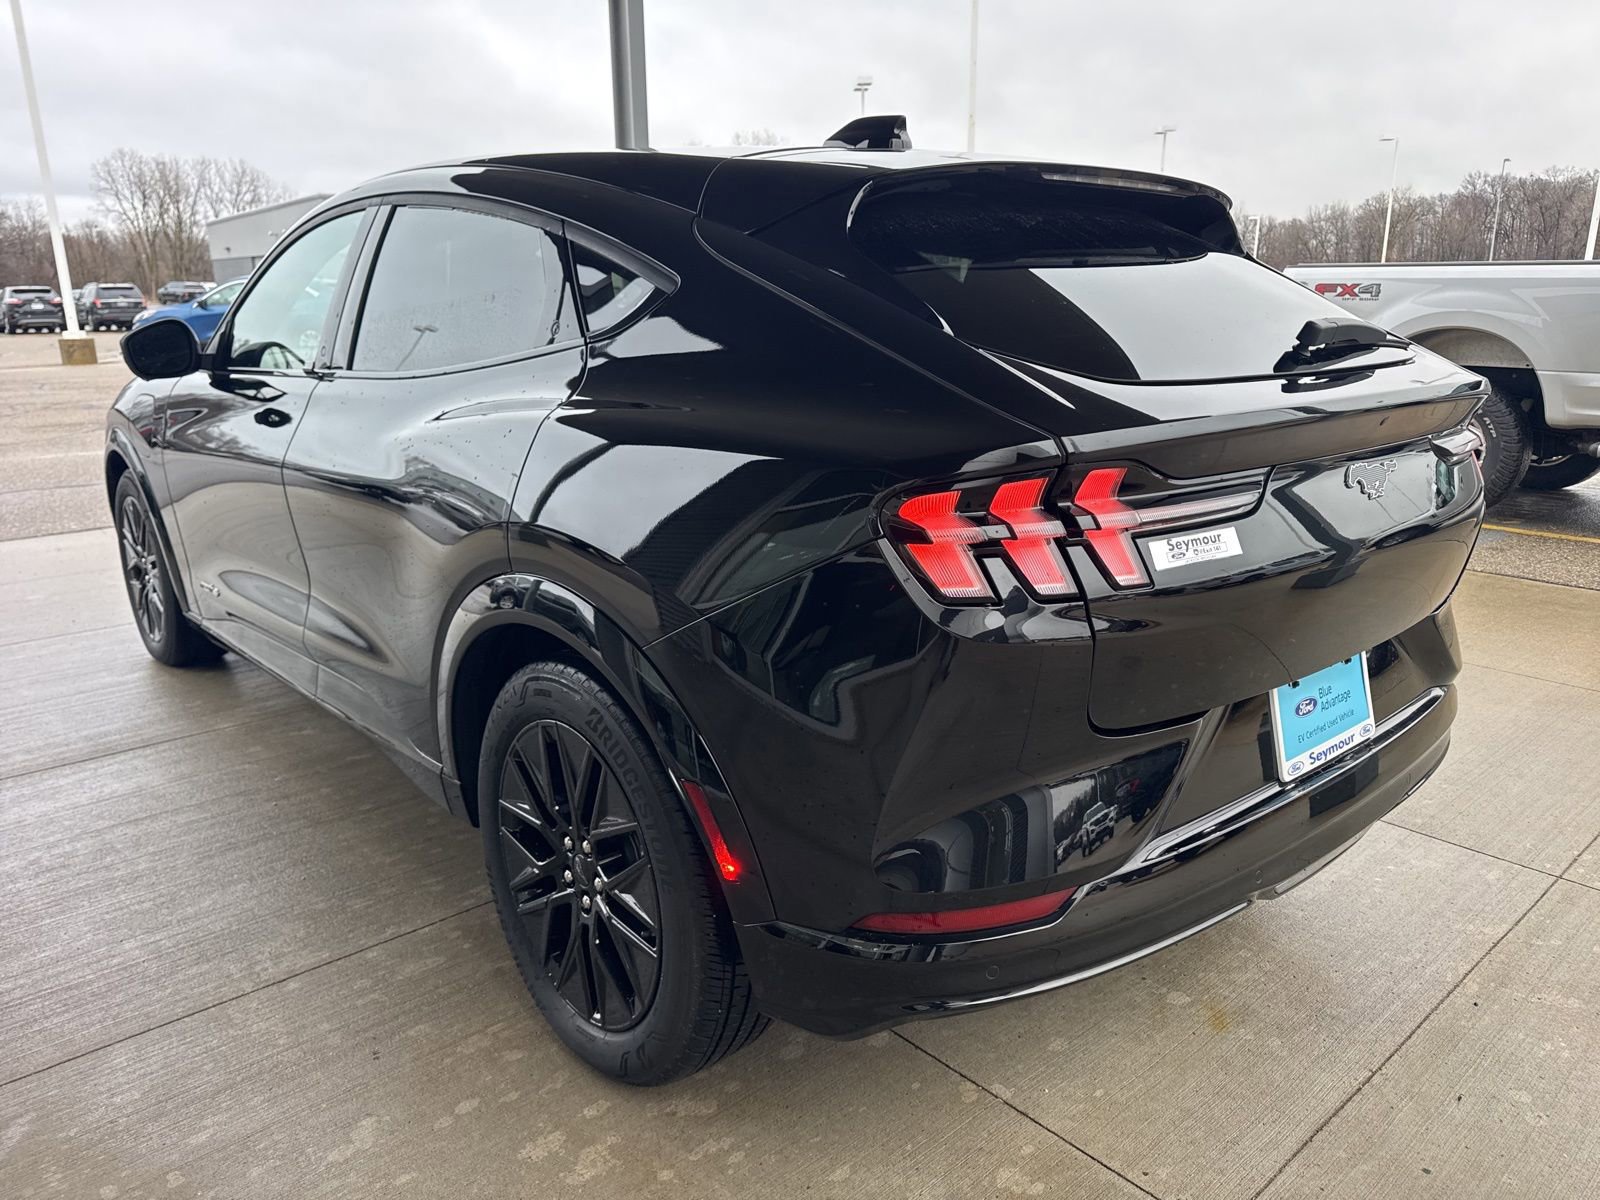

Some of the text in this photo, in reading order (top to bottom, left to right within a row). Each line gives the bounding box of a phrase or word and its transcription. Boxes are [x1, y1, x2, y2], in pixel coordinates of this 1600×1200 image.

[1315, 283, 1381, 297] FX4
[1167, 534, 1221, 552] Seymour
[1318, 685, 1332, 699] Blue
[1320, 689, 1351, 712] Advantage
[1297, 699, 1316, 716] Ford
[1298, 708, 1354, 744] EV Certified Used Vehicle
[1308, 733, 1355, 765] Seymour
